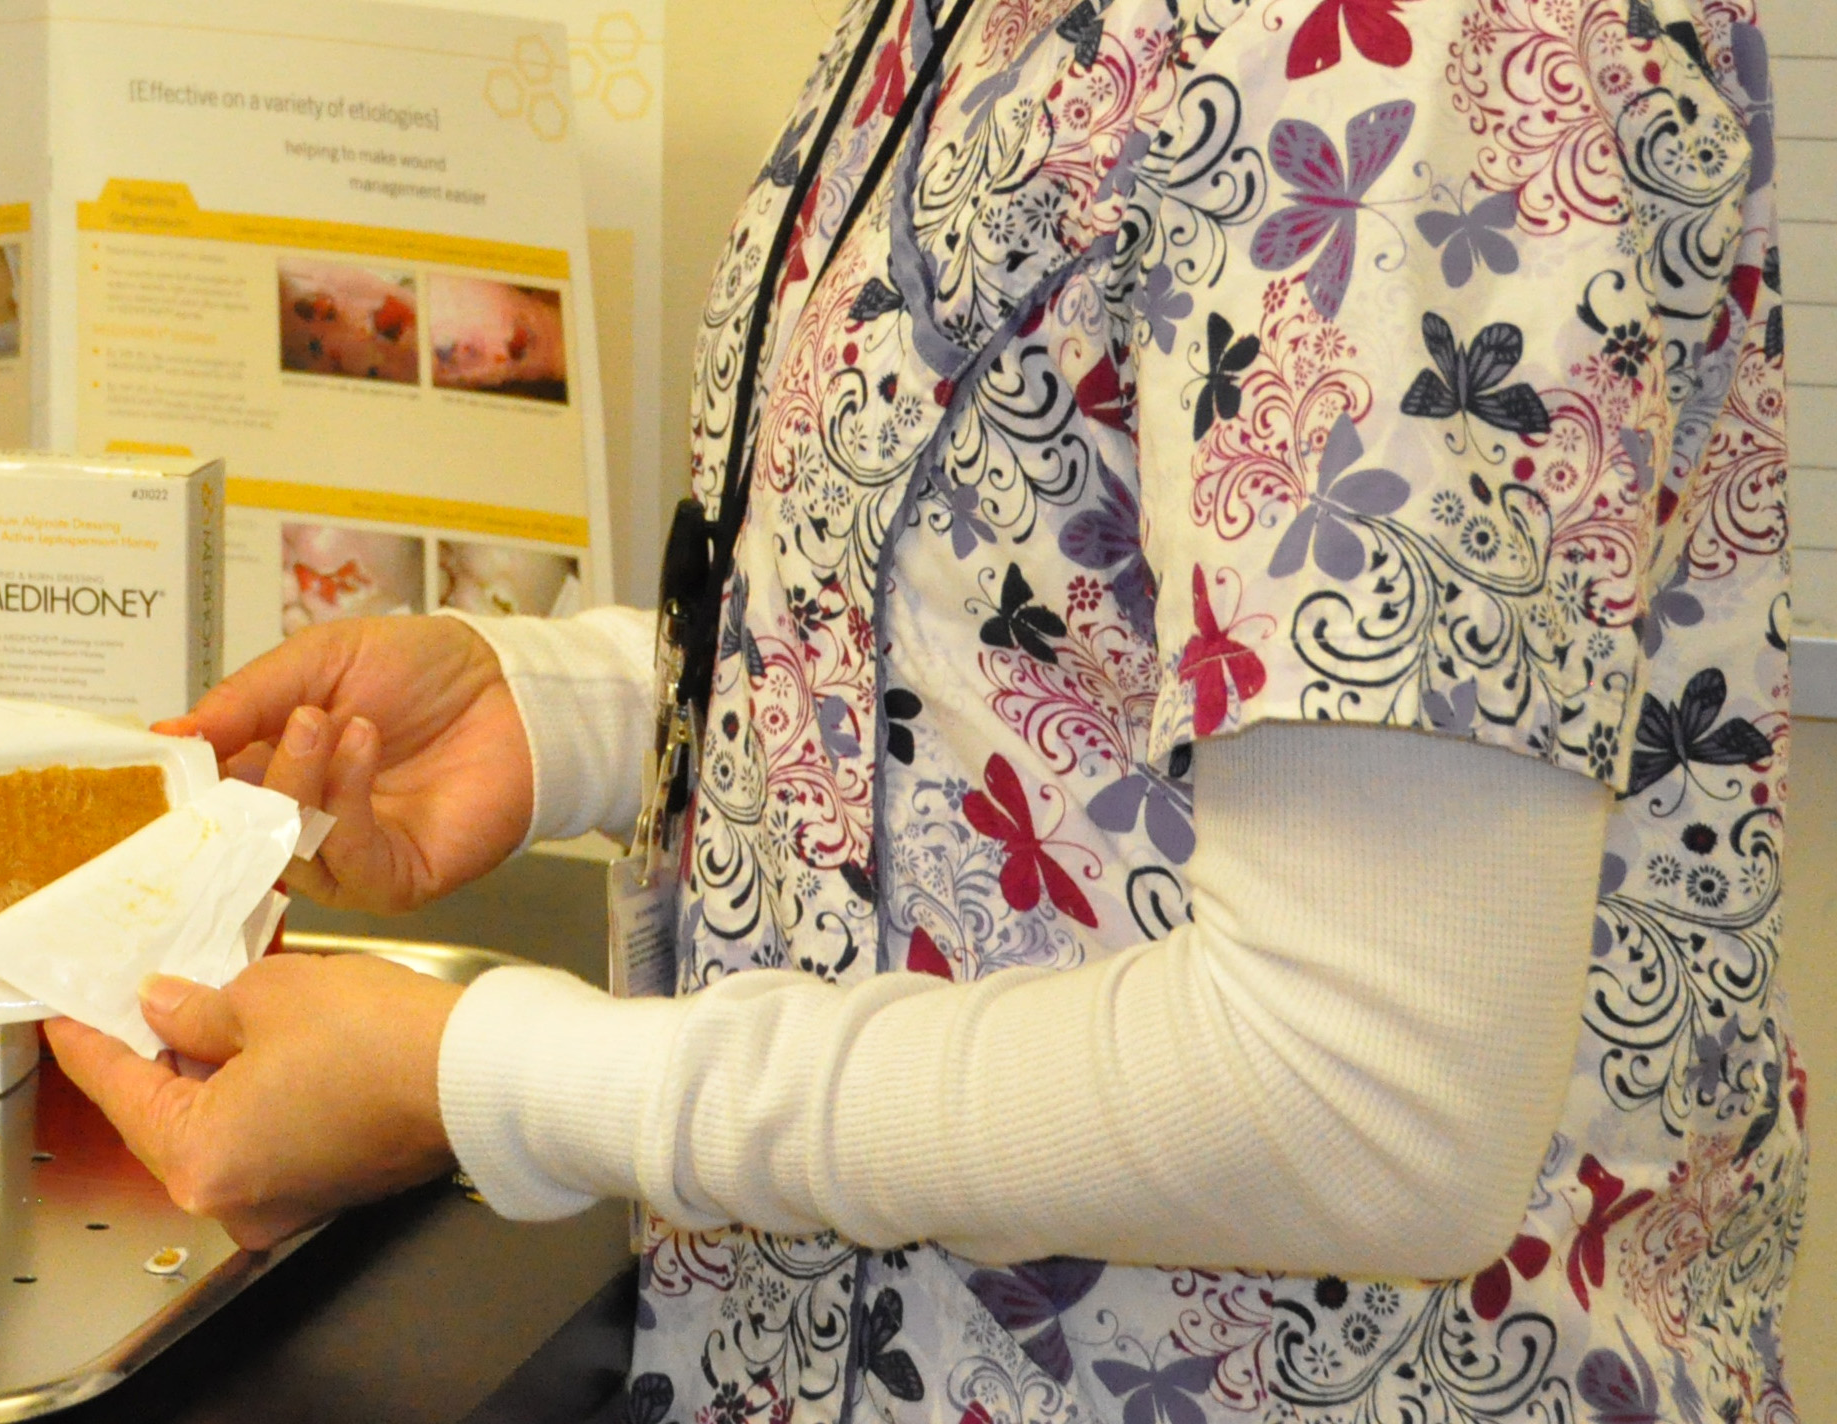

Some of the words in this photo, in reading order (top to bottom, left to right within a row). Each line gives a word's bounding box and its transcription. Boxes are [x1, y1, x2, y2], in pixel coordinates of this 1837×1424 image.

[128, 78, 218, 109] [Effective
[221, 90, 246, 109] on
[249, 94, 261, 112] a
[264, 93, 324, 121] variety
[326, 99, 346, 120] of
[348, 102, 441, 132] etiologies]
[285, 139, 339, 164] helping
[340, 144, 356, 162] to
[359, 146, 398, 168] make
[399, 152, 447, 173] wound
[348, 176, 443, 201] management
[444, 186, 487, 207] easier
[72, 517, 122, 535] Dressing
[0, 529, 35, 545] Active
[121, 536, 160, 552] Honey
[56, 574, 106, 585] DRESSING
